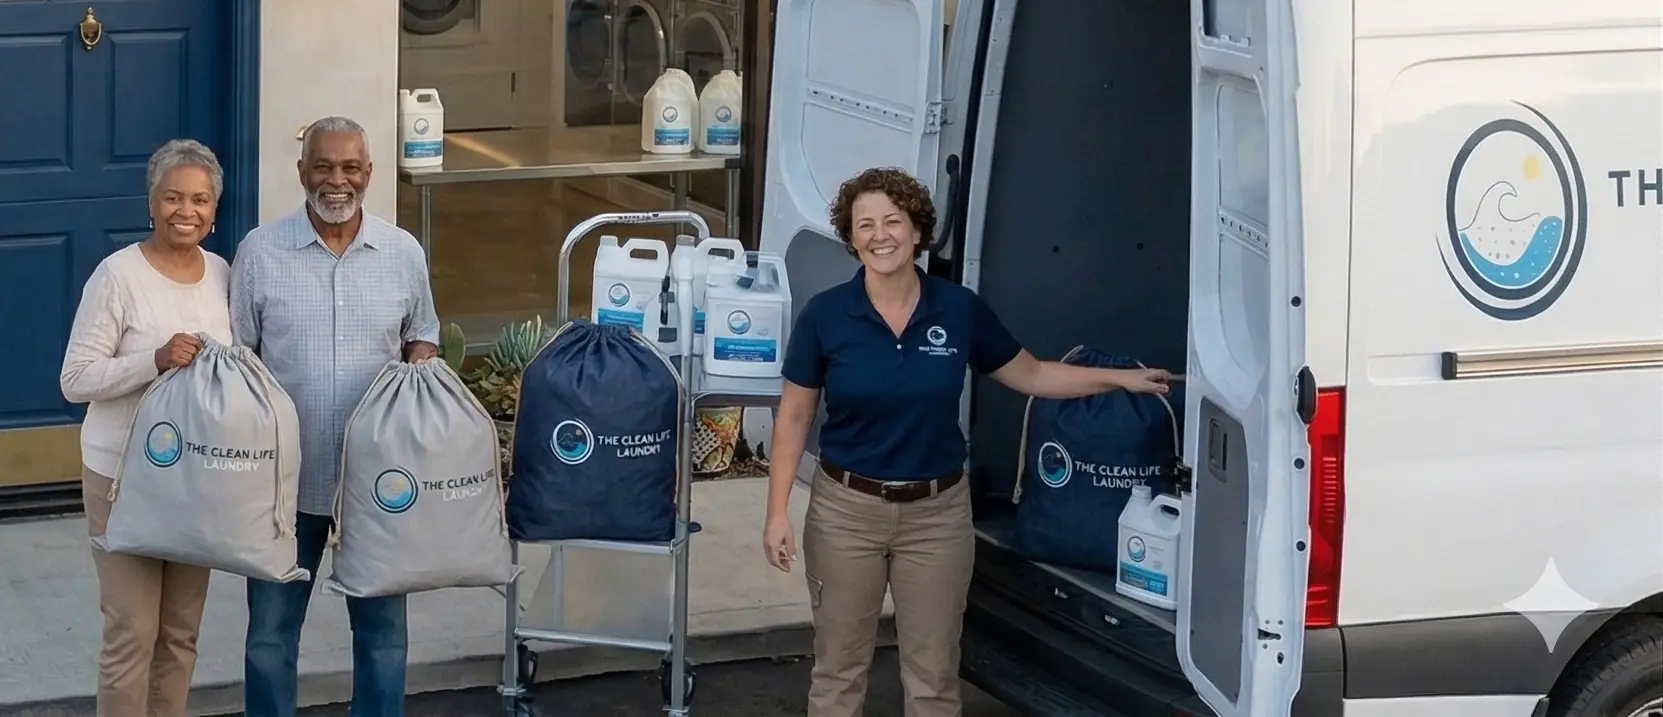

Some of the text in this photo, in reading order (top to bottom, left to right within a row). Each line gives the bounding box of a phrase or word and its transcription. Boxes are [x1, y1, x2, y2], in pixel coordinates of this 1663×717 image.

[597, 435, 619, 446] THE
[621, 432, 654, 446] CLEAN
[186, 441, 208, 456] THE
[211, 447, 250, 460] CLEAN
[204, 459, 260, 472] LAUNDRY
[1075, 461, 1161, 477] THE CLEAN LIFE
[422, 480, 444, 492] THE
[446, 473, 479, 489] CLEAN
